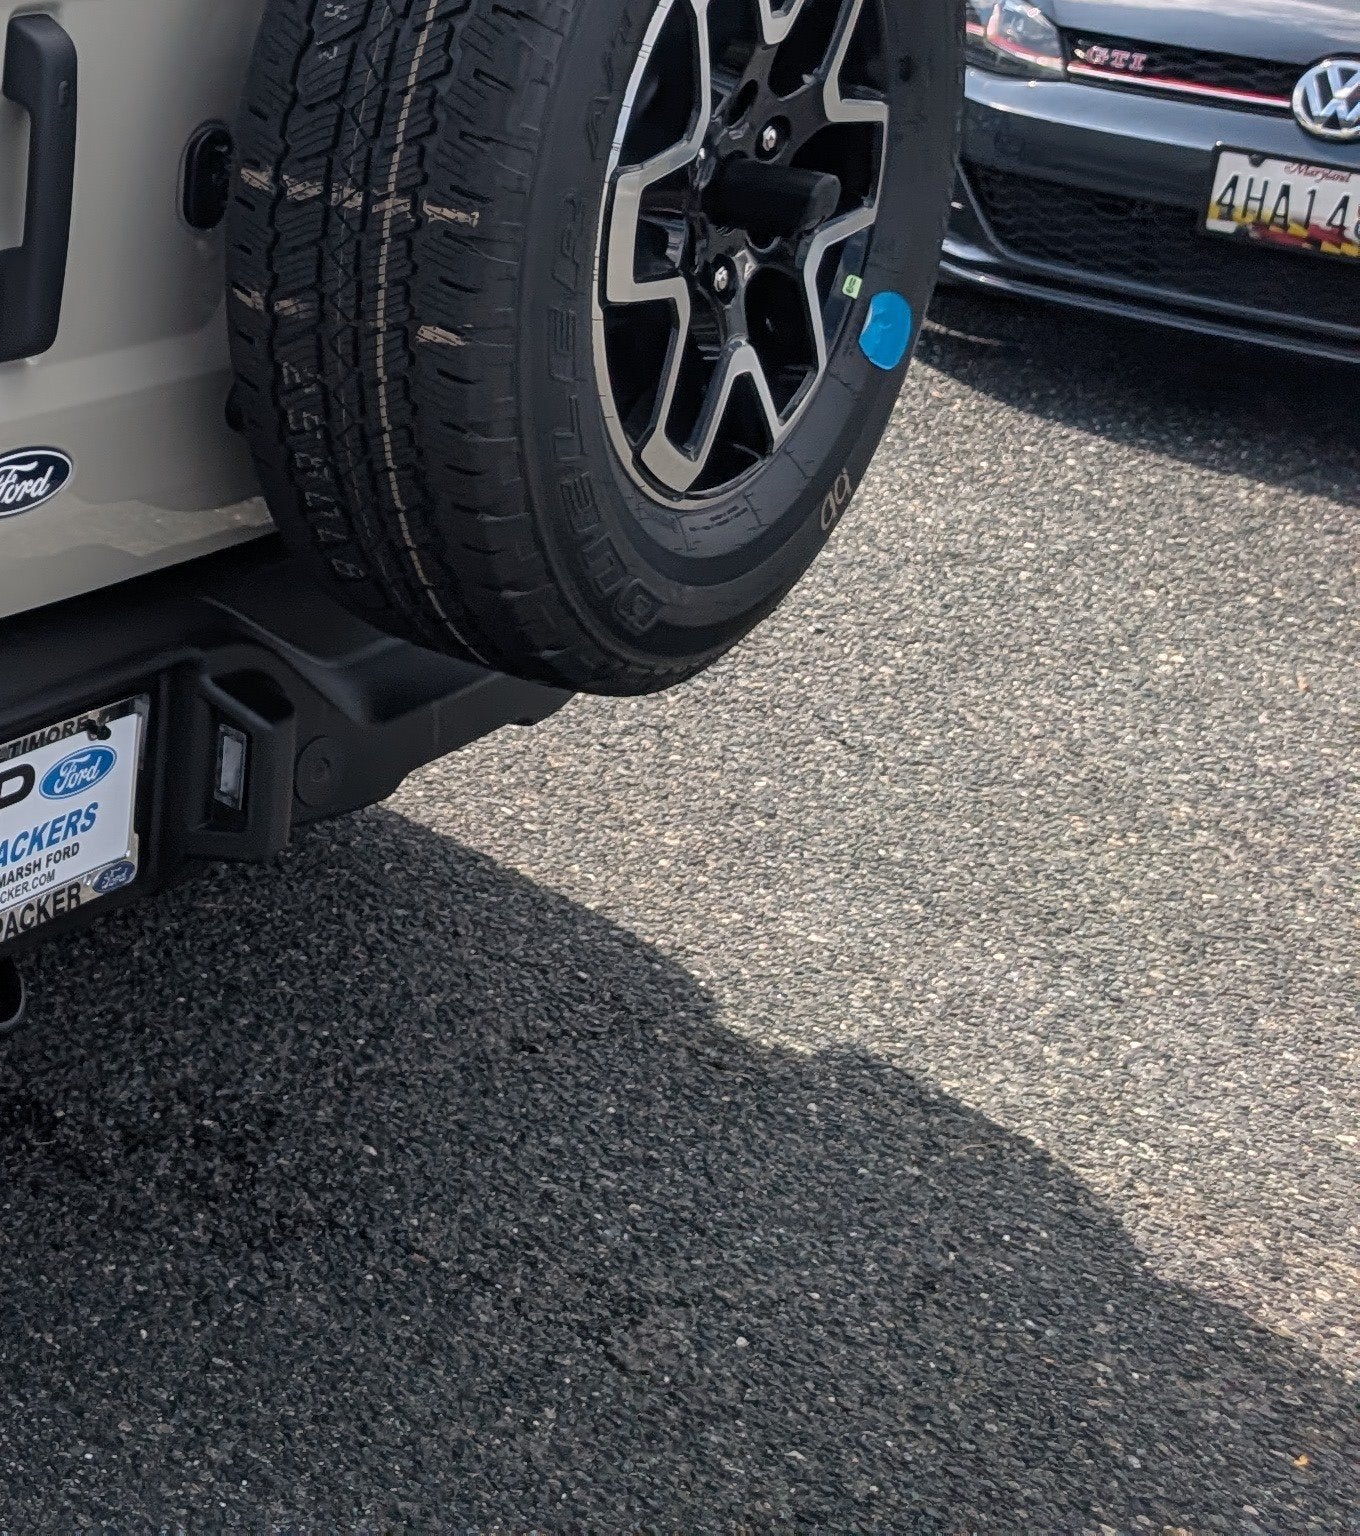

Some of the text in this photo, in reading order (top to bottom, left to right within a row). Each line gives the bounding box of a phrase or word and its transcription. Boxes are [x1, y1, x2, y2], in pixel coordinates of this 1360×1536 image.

[1085, 45, 1148, 72] GTI
[1284, 163, 1353, 184] Maryland
[1216, 173, 1360, 241] 4HA14
[51, 751, 104, 796] Ford
[45, 842, 80, 869] FORD
[98, 864, 130, 891] Ford
